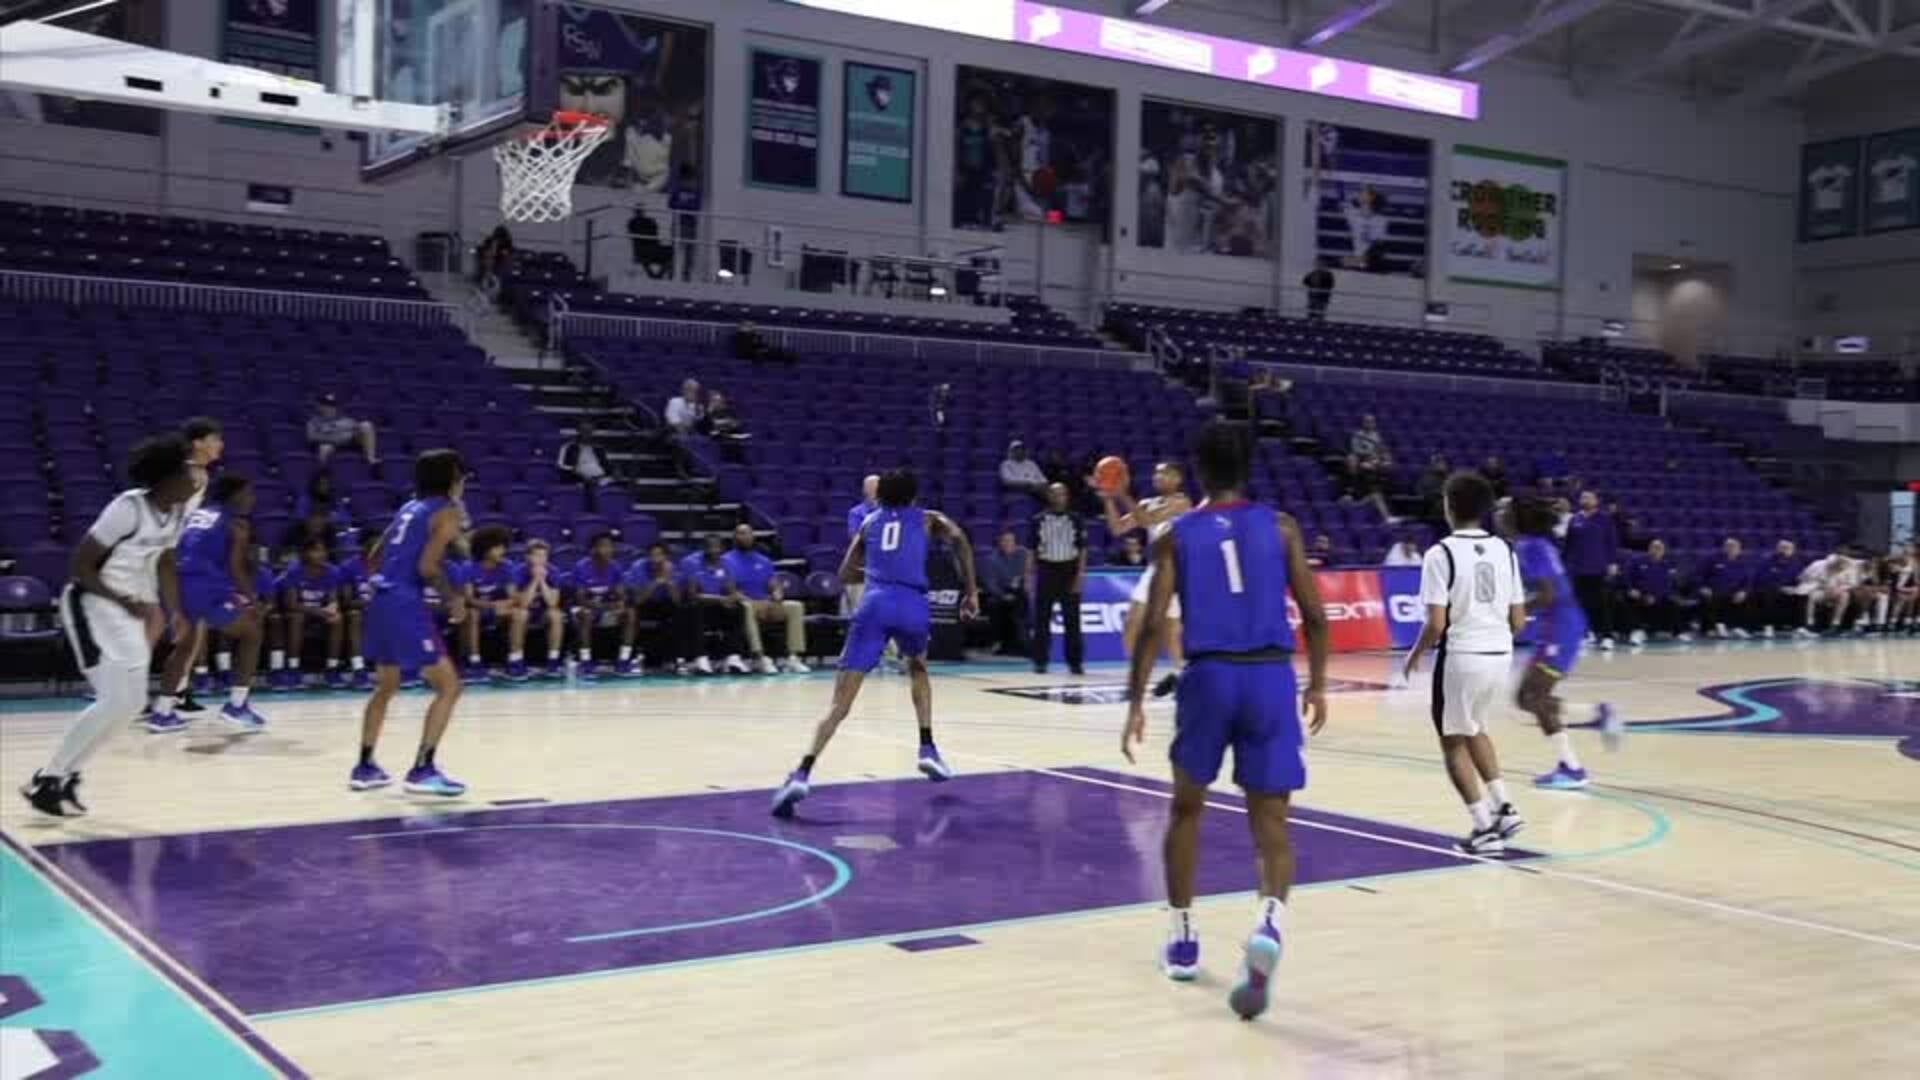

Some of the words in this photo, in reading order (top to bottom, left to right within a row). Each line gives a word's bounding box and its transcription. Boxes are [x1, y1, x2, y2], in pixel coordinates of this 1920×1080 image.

[881, 521, 901, 551] 0
[1220, 538, 1244, 593] 1
[1049, 602, 1131, 634] EIC
